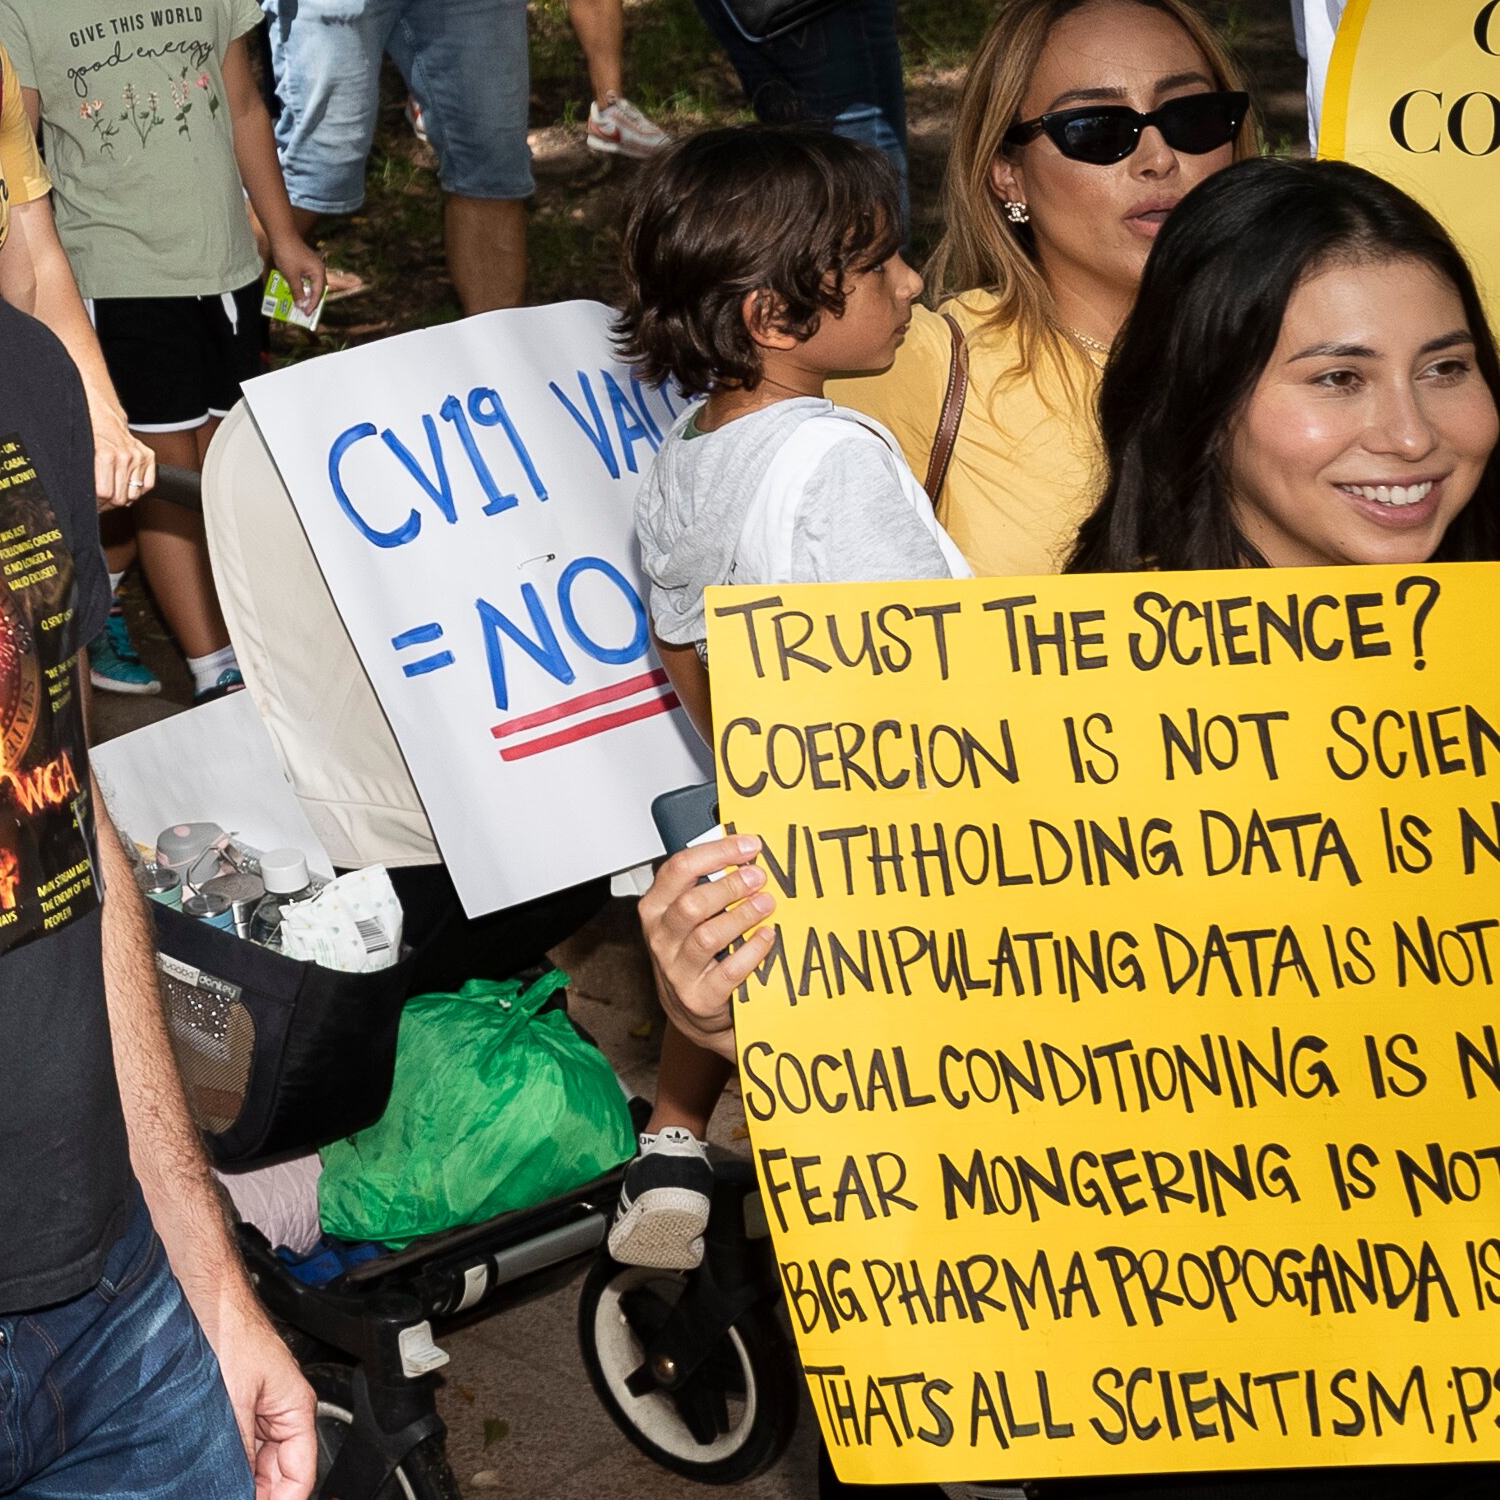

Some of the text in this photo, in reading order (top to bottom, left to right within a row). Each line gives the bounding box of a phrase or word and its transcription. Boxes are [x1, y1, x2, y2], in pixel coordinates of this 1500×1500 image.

[67, 40, 215, 98] good energy
[69, 7, 202, 47] GIVE THIS WORLD
[1389, 89, 1500, 157] CO
[328, 386, 550, 550] CV19
[714, 574, 1441, 683] TRUST THE SCIENCE?
[719, 704, 1500, 799] COERCION IS NOT SCIEN
[1202, 808, 1363, 887] DATA
[1381, 806, 1432, 875] IS
[199, 975, 236, 998] donkey
[734, 916, 1499, 1006] MANIPULATING DATA IS NOT
[740, 1041, 937, 1124] SOCIAL
[939, 1026, 1340, 1116] CONDITIONING
[1365, 1033, 1428, 1100] IS
[759, 1146, 919, 1234] FEAR
[944, 1142, 1303, 1224] MONGERING
[1325, 1142, 1381, 1211] IS
[780, 1238, 1500, 1335] BIG PHARMA PROPOGANDA IS
[804, 1364, 954, 1449] THATS
[970, 1369, 1074, 1449] ALL
